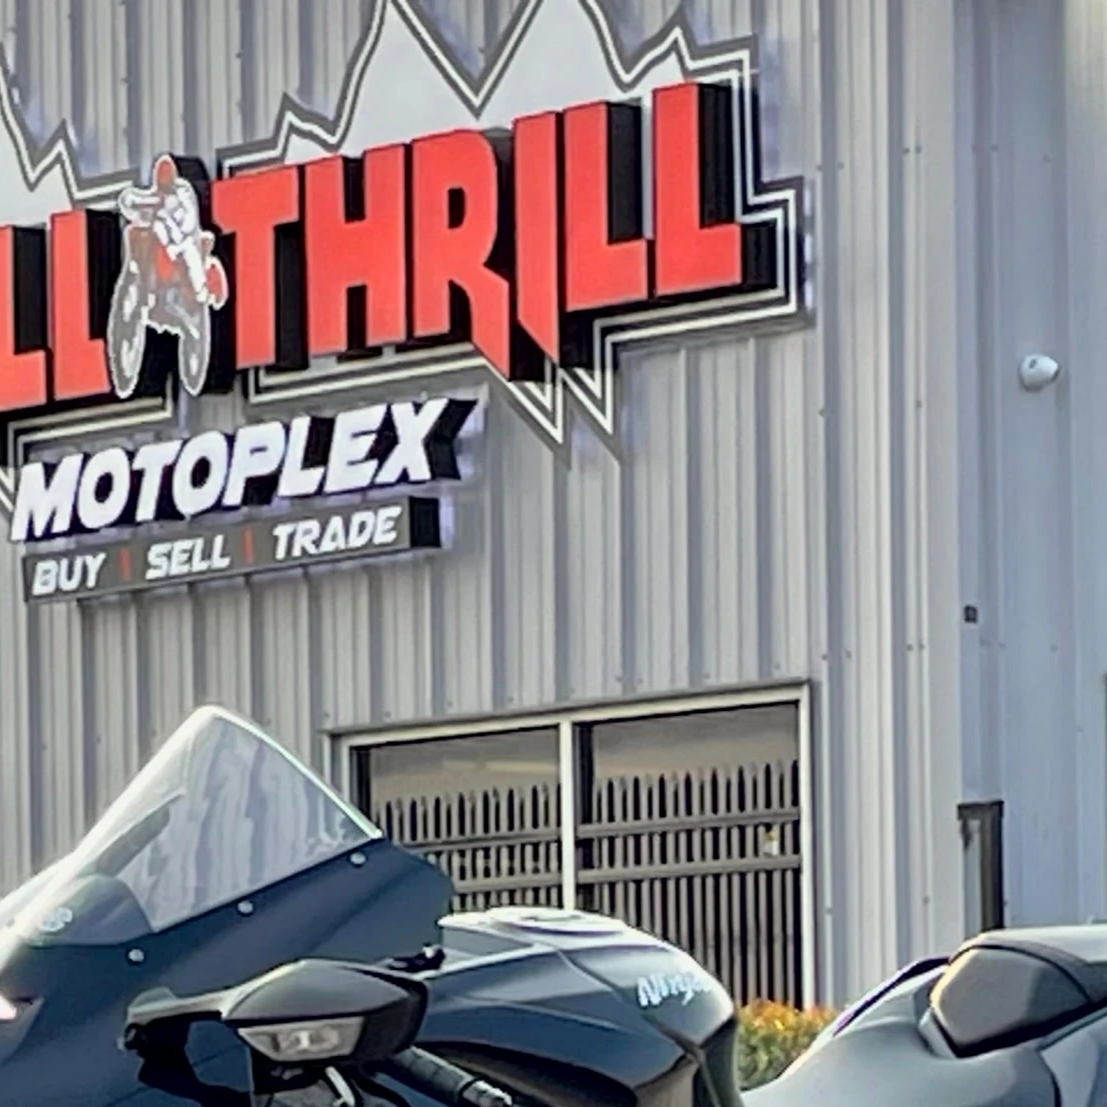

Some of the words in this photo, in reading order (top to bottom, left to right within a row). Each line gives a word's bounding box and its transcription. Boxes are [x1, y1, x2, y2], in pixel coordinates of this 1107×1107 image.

[212, 82, 742, 380] THRILL
[11, 398, 449, 541] MOTOPLEX
[32, 553, 106, 596] BUY
[145, 534, 231, 580] SELL
[272, 506, 403, 560] TRADE
